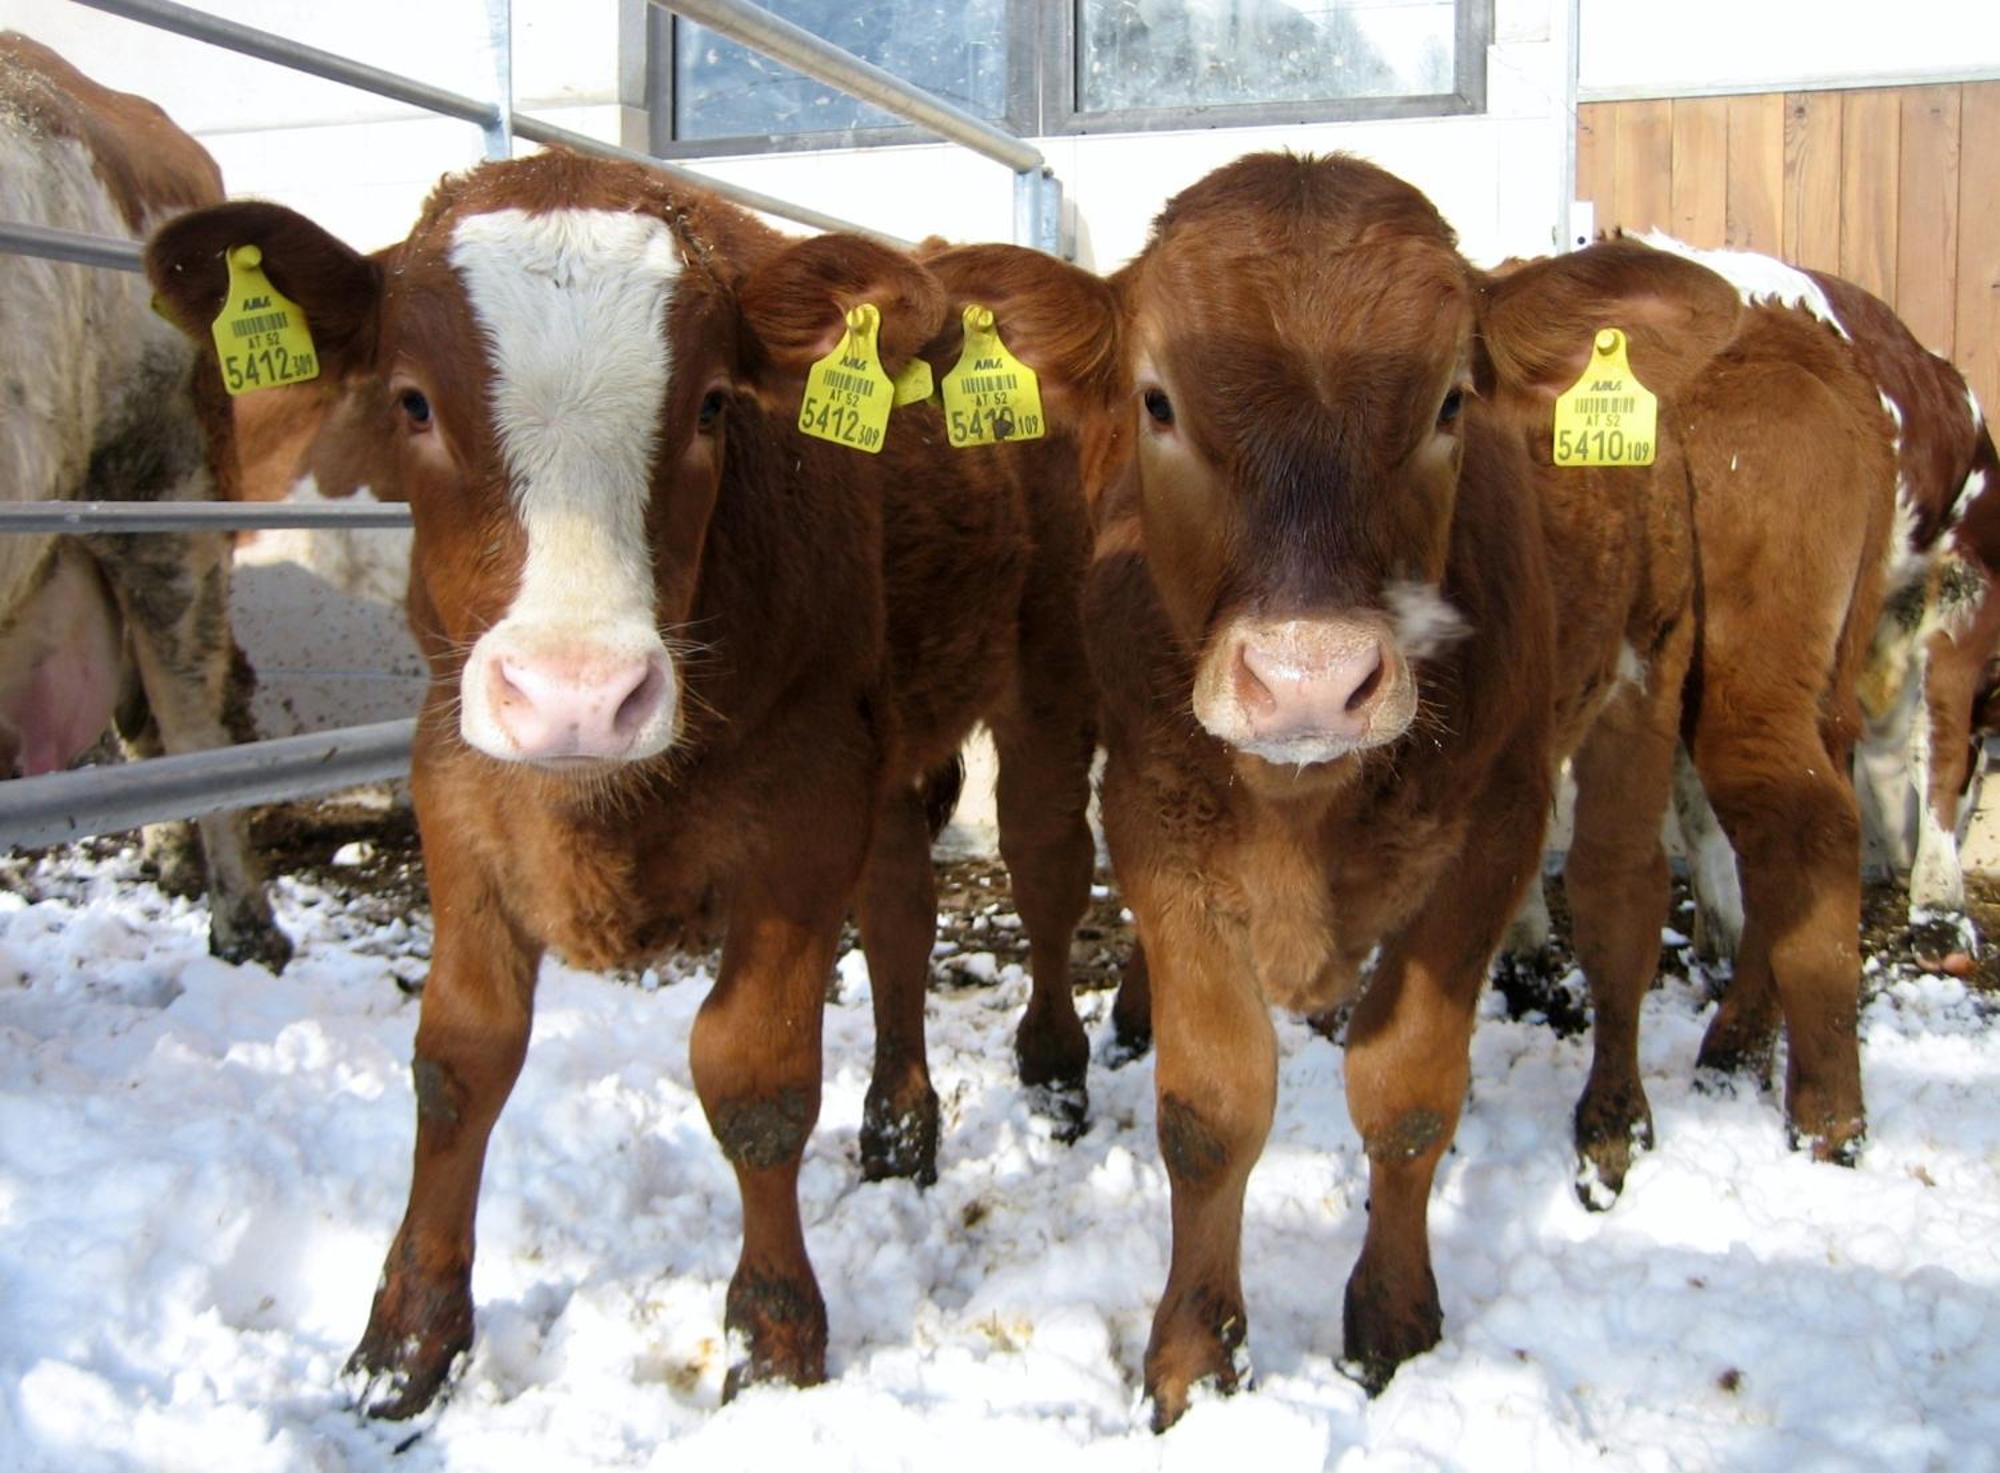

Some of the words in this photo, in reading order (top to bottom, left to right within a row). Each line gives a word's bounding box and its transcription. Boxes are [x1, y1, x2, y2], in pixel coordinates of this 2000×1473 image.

[248, 335, 261, 349] AT
[266, 332, 280, 346] 52
[226, 347, 293, 389] 5412
[830, 389, 842, 402] AT
[846, 393, 859, 408] 52
[976, 394, 988, 407] AT
[994, 392, 1008, 405] 52
[802, 397, 860, 442] 5412
[858, 424, 880, 448] 309
[1019, 415, 1038, 435] 109
[1586, 415, 1599, 427] AT
[1605, 415, 1621, 427] 52
[1558, 430, 1624, 461] 5410
[1628, 442, 1649, 461] 109
